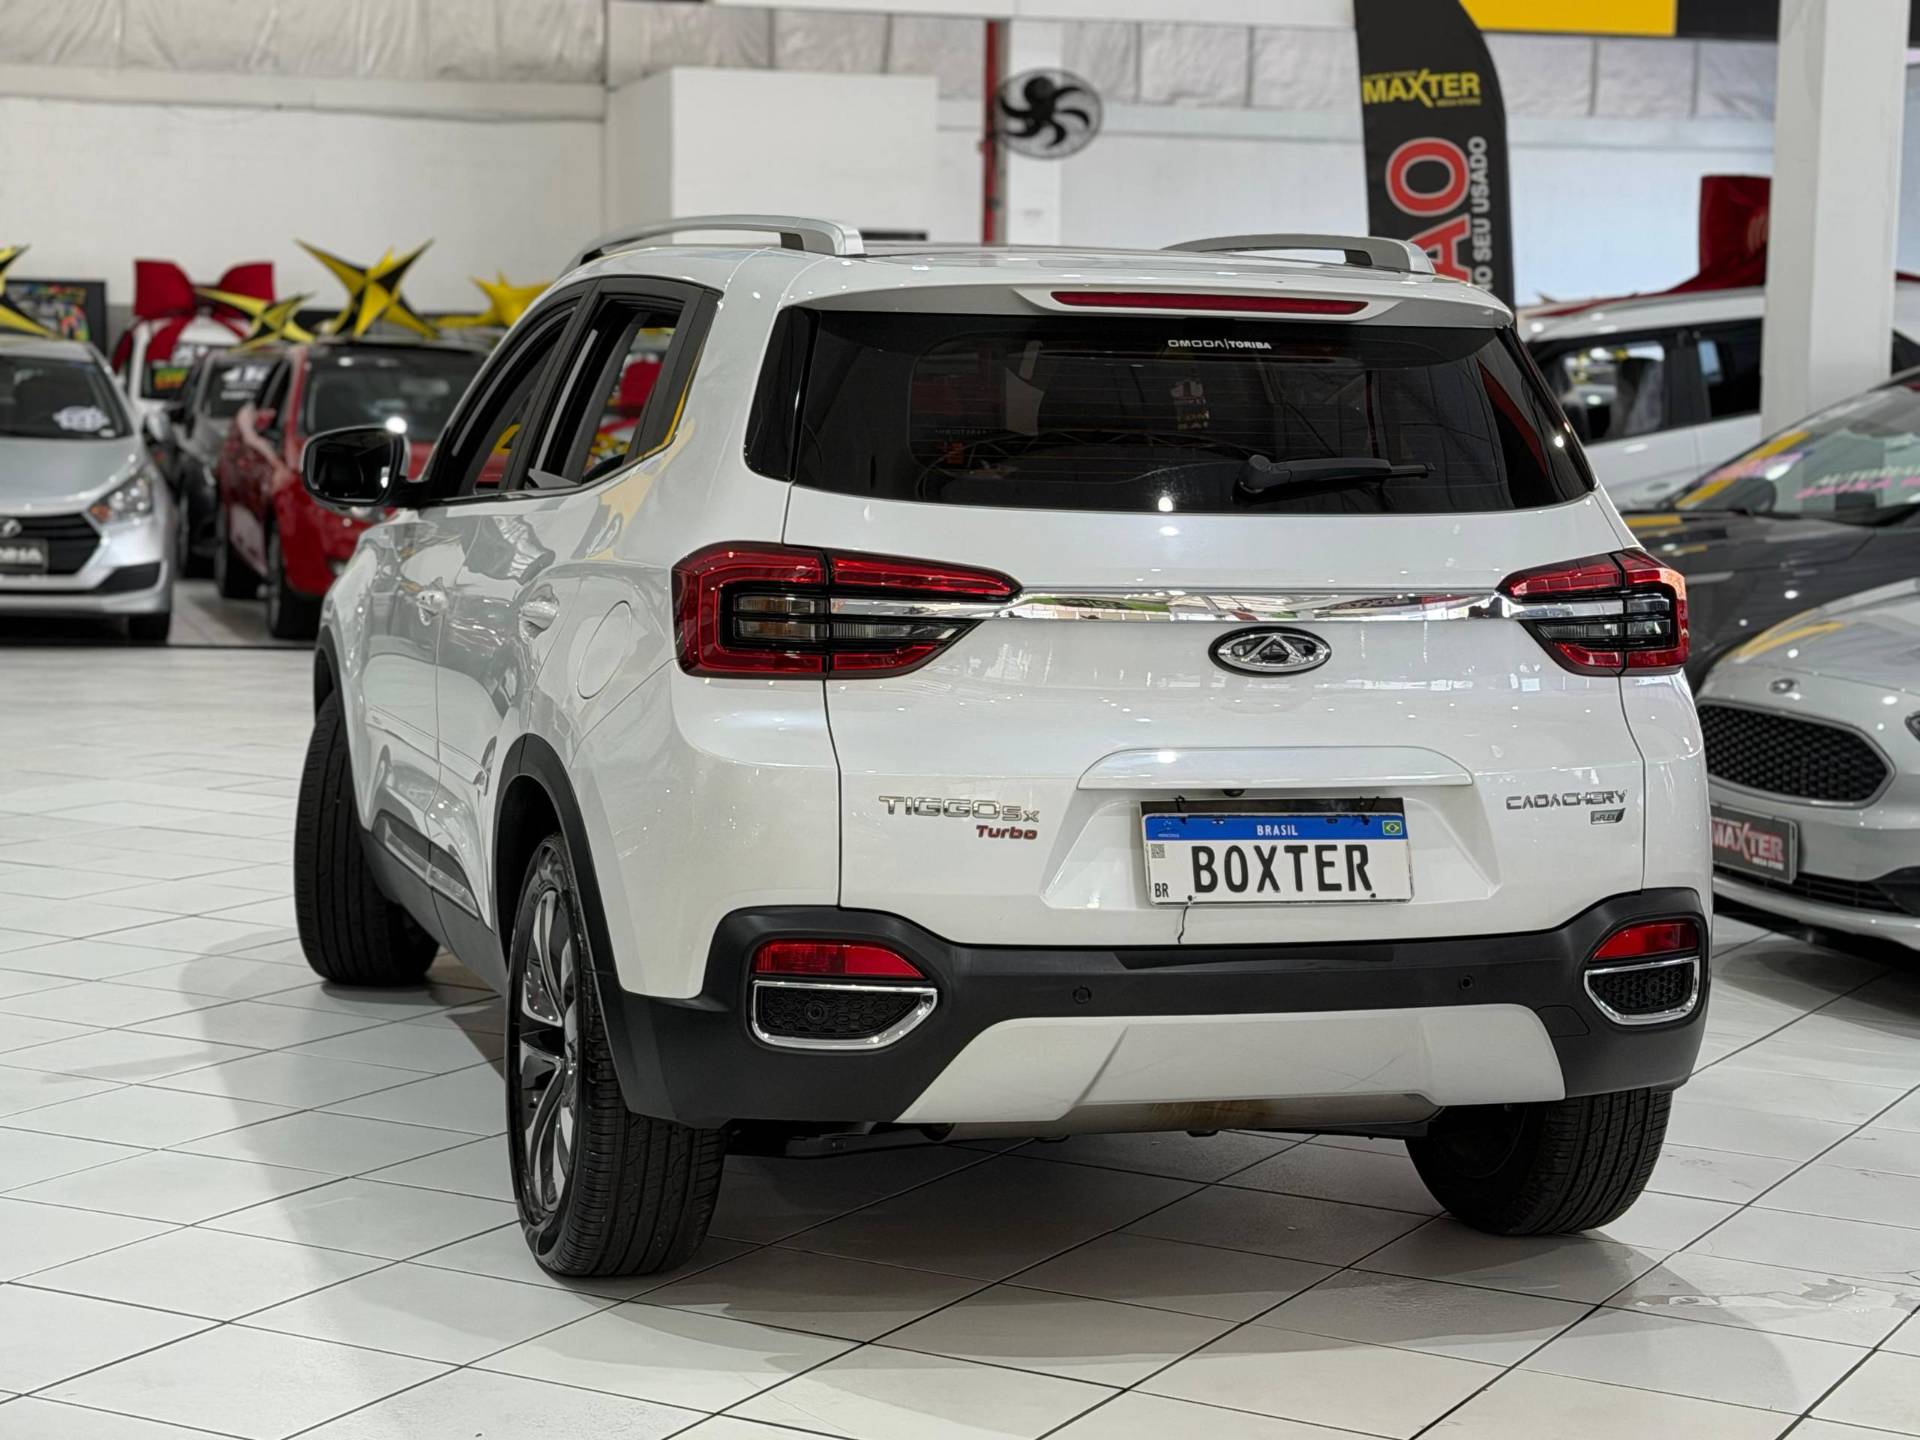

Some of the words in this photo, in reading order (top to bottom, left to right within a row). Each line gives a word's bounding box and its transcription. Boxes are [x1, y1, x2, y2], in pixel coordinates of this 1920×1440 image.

[1362, 68, 1481, 108] MAXTER
[1467, 135, 1491, 214] USADO
[1471, 217, 1493, 263] SEU
[976, 824, 1039, 840] Turbo
[1256, 824, 1299, 837] BRASIL
[1191, 844, 1373, 894] BOXTER
[1154, 882, 1169, 898] BR
